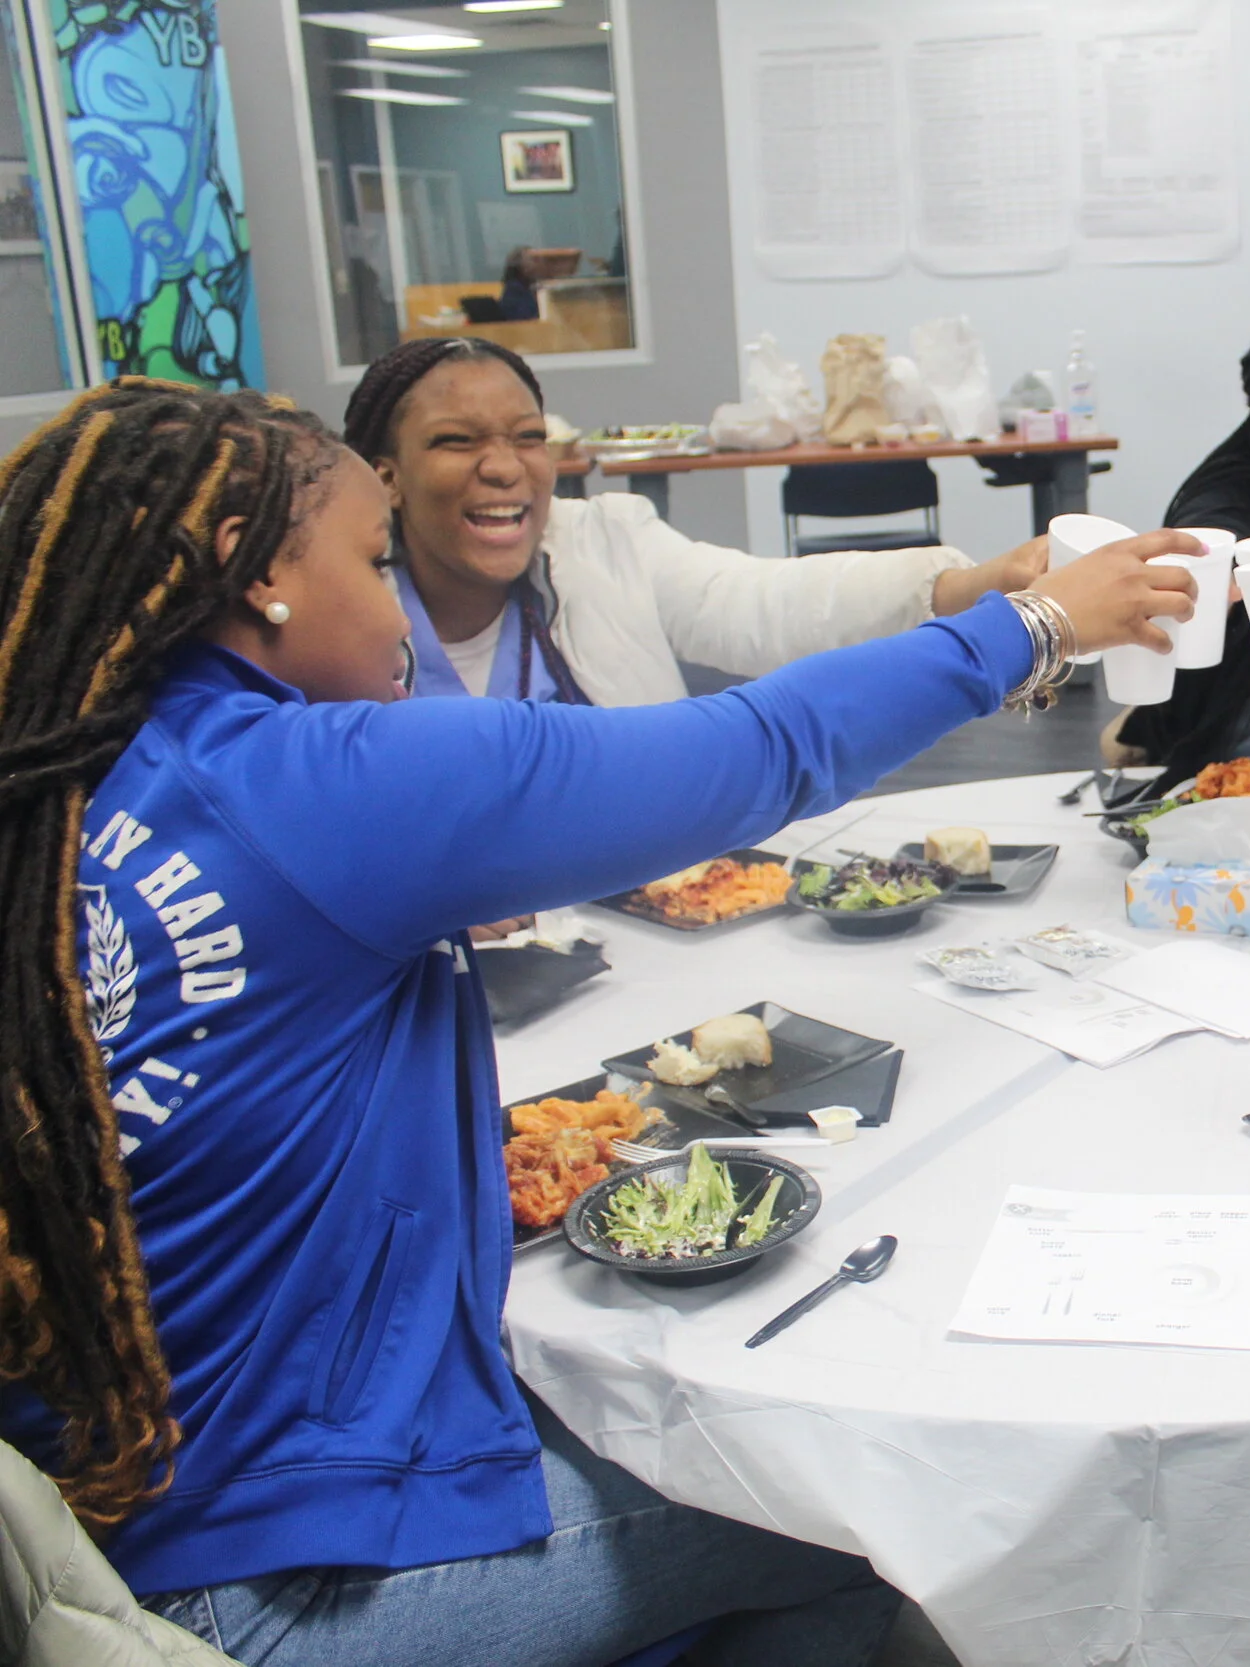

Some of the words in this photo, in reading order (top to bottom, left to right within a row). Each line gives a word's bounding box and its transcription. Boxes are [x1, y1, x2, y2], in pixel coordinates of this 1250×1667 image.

[140, 10, 207, 68] YB
[80, 798, 153, 870] AY
[134, 851, 247, 1003] HARD
